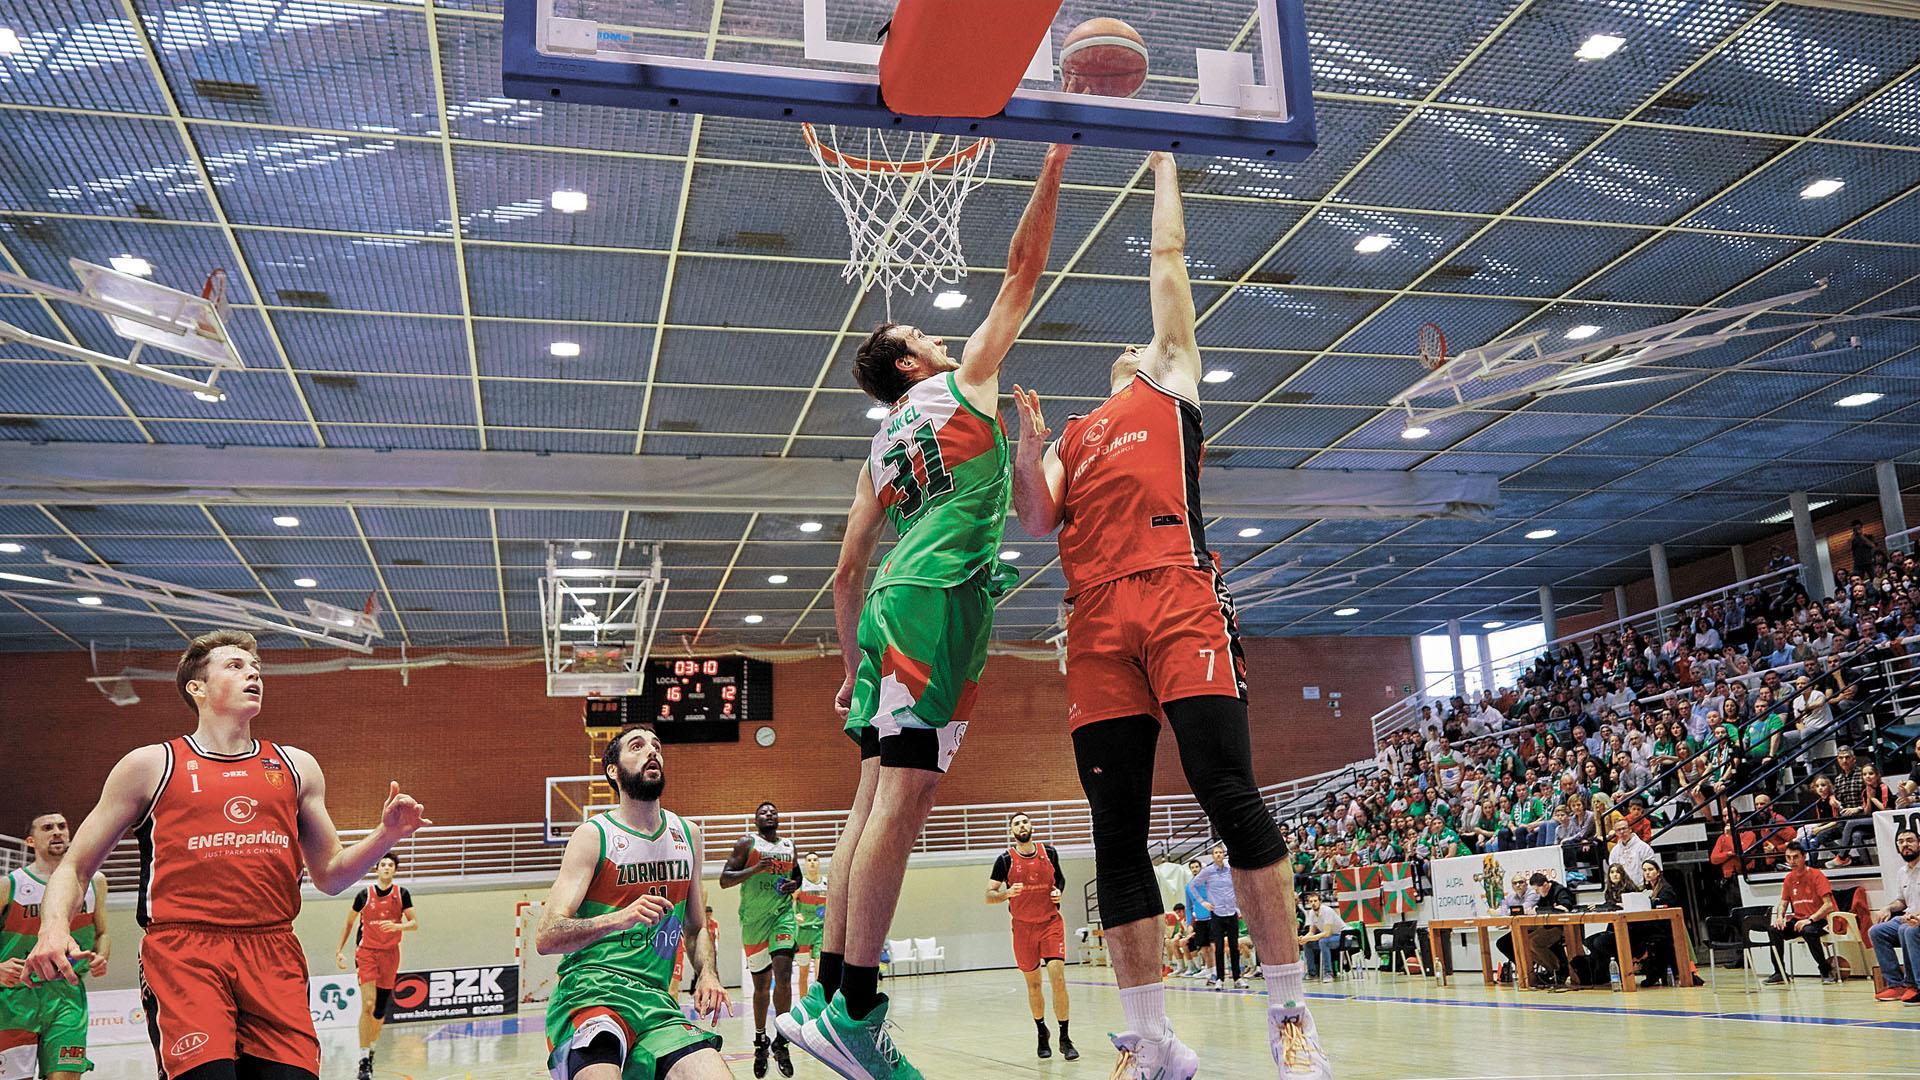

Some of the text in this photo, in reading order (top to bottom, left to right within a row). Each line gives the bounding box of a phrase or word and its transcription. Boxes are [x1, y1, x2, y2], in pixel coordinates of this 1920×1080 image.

[880, 418, 954, 519] 31
[675, 660, 718, 676] 03:10
[1199, 649, 1215, 681] 7
[666, 686, 682, 702] 16
[721, 685, 737, 701] 12
[661, 704, 670, 716] 3
[723, 703, 732, 715] 2
[190, 773, 202, 793] 1
[187, 830, 290, 850] ENERparking
[204, 850, 222, 859] JUST
[616, 859, 690, 886] ZORNOTZA
[1446, 877, 1464, 888] AUPA
[619, 925, 682, 949] teknei
[429, 967, 505, 998] BZK
[176, 1035, 203, 1053] KIA
